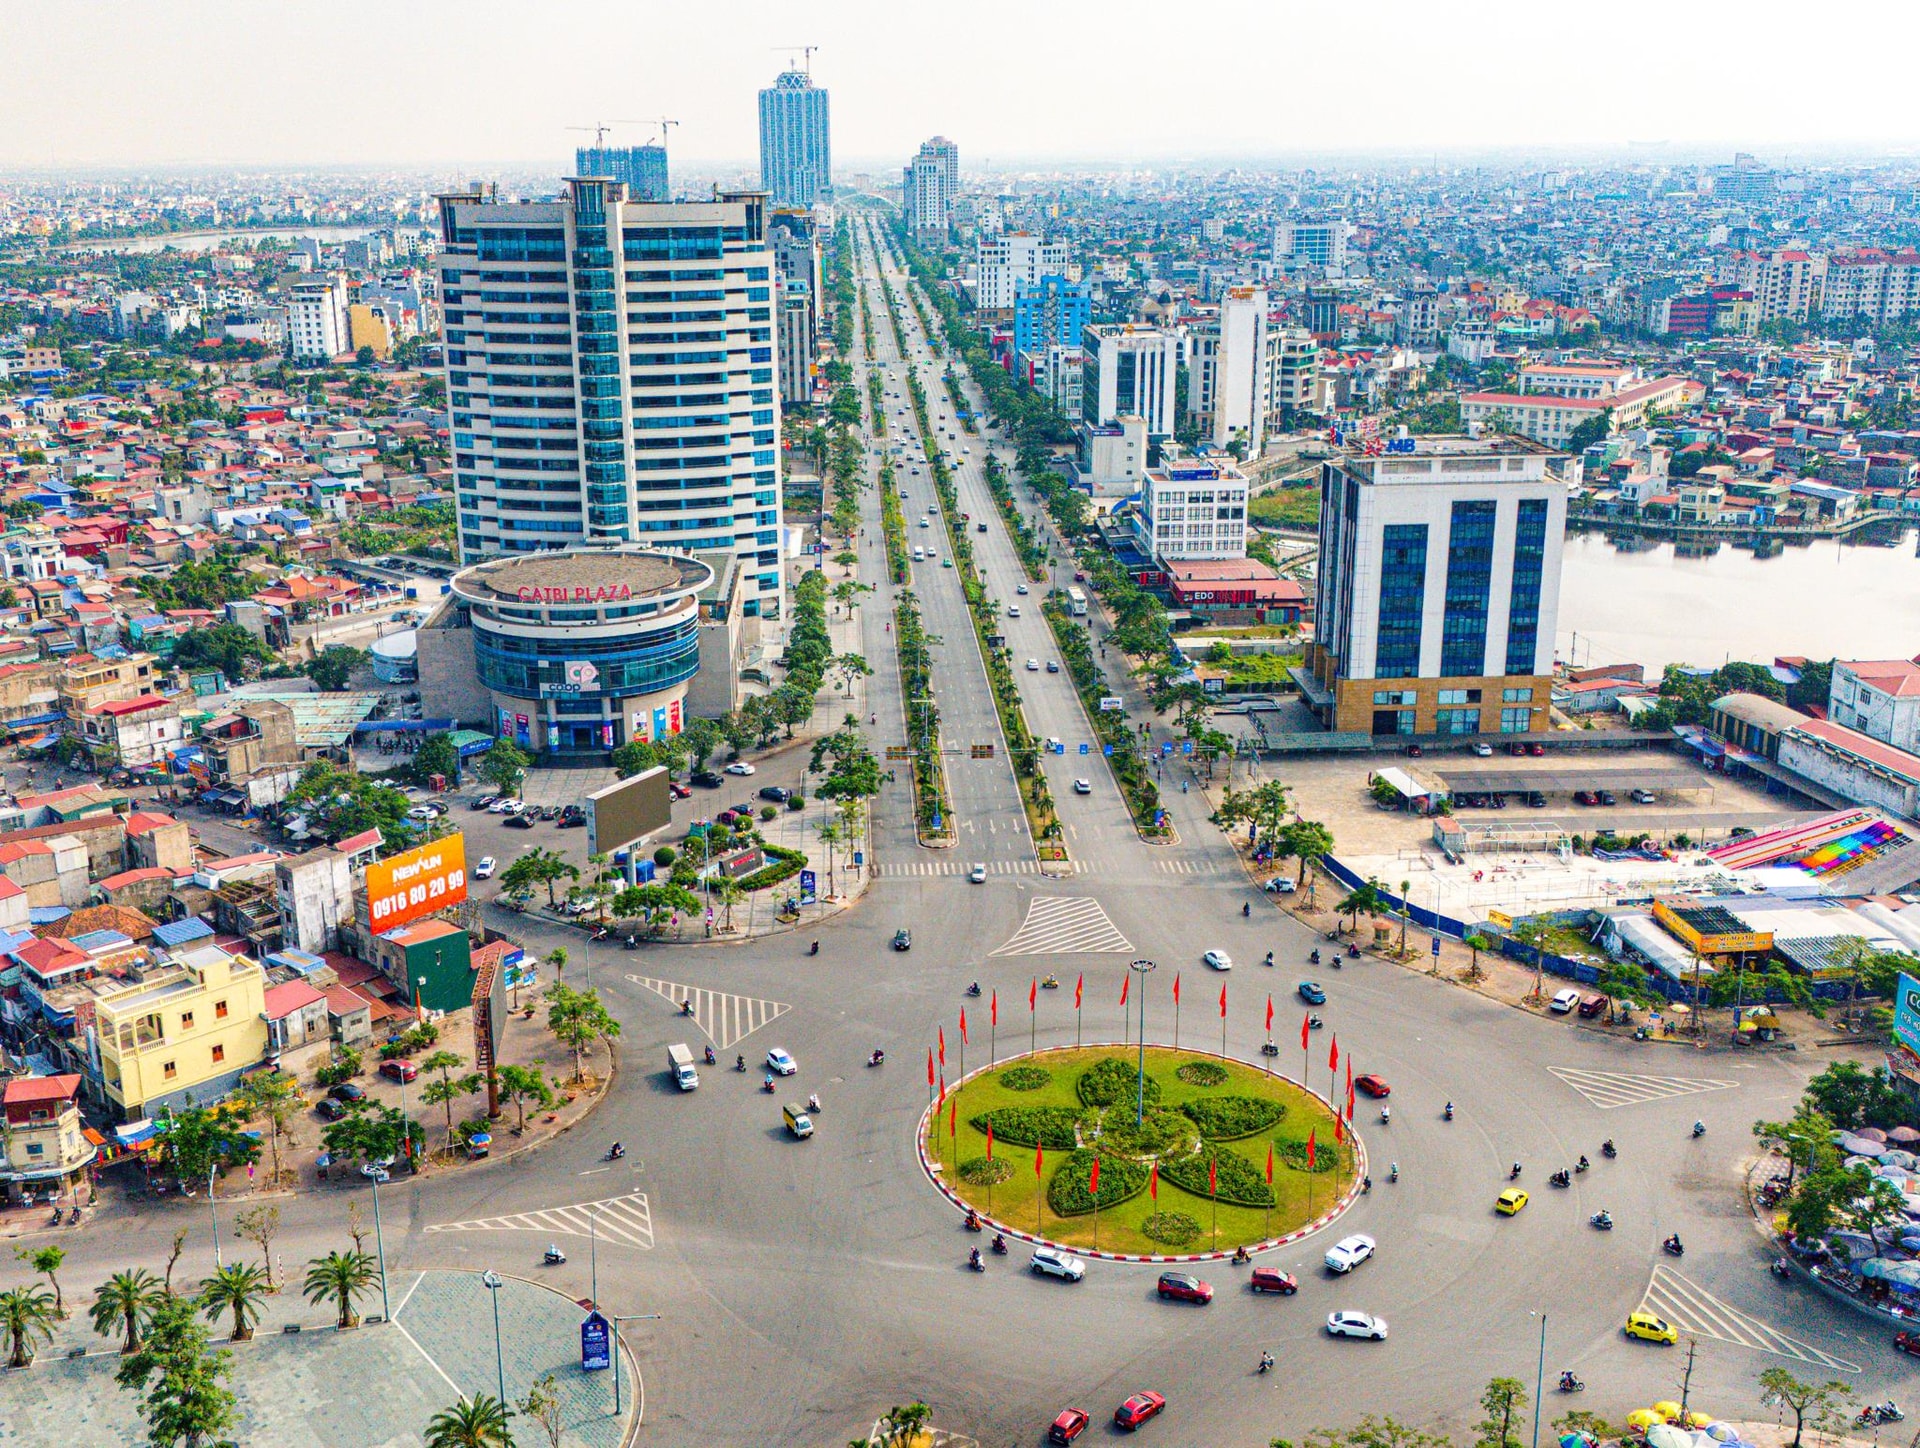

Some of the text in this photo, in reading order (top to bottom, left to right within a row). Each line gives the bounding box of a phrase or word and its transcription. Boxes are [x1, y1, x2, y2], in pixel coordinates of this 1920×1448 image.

[1101, 327, 1125, 337] BIDV
[1386, 439, 1415, 453] MB
[518, 584, 632, 602] CATBI PLAZA
[1194, 592, 1214, 600] EDO
[373, 891, 407, 919] 0916
[409, 884, 426, 906] 80
[429, 876, 446, 898] 20
[448, 869, 464, 891] 99
